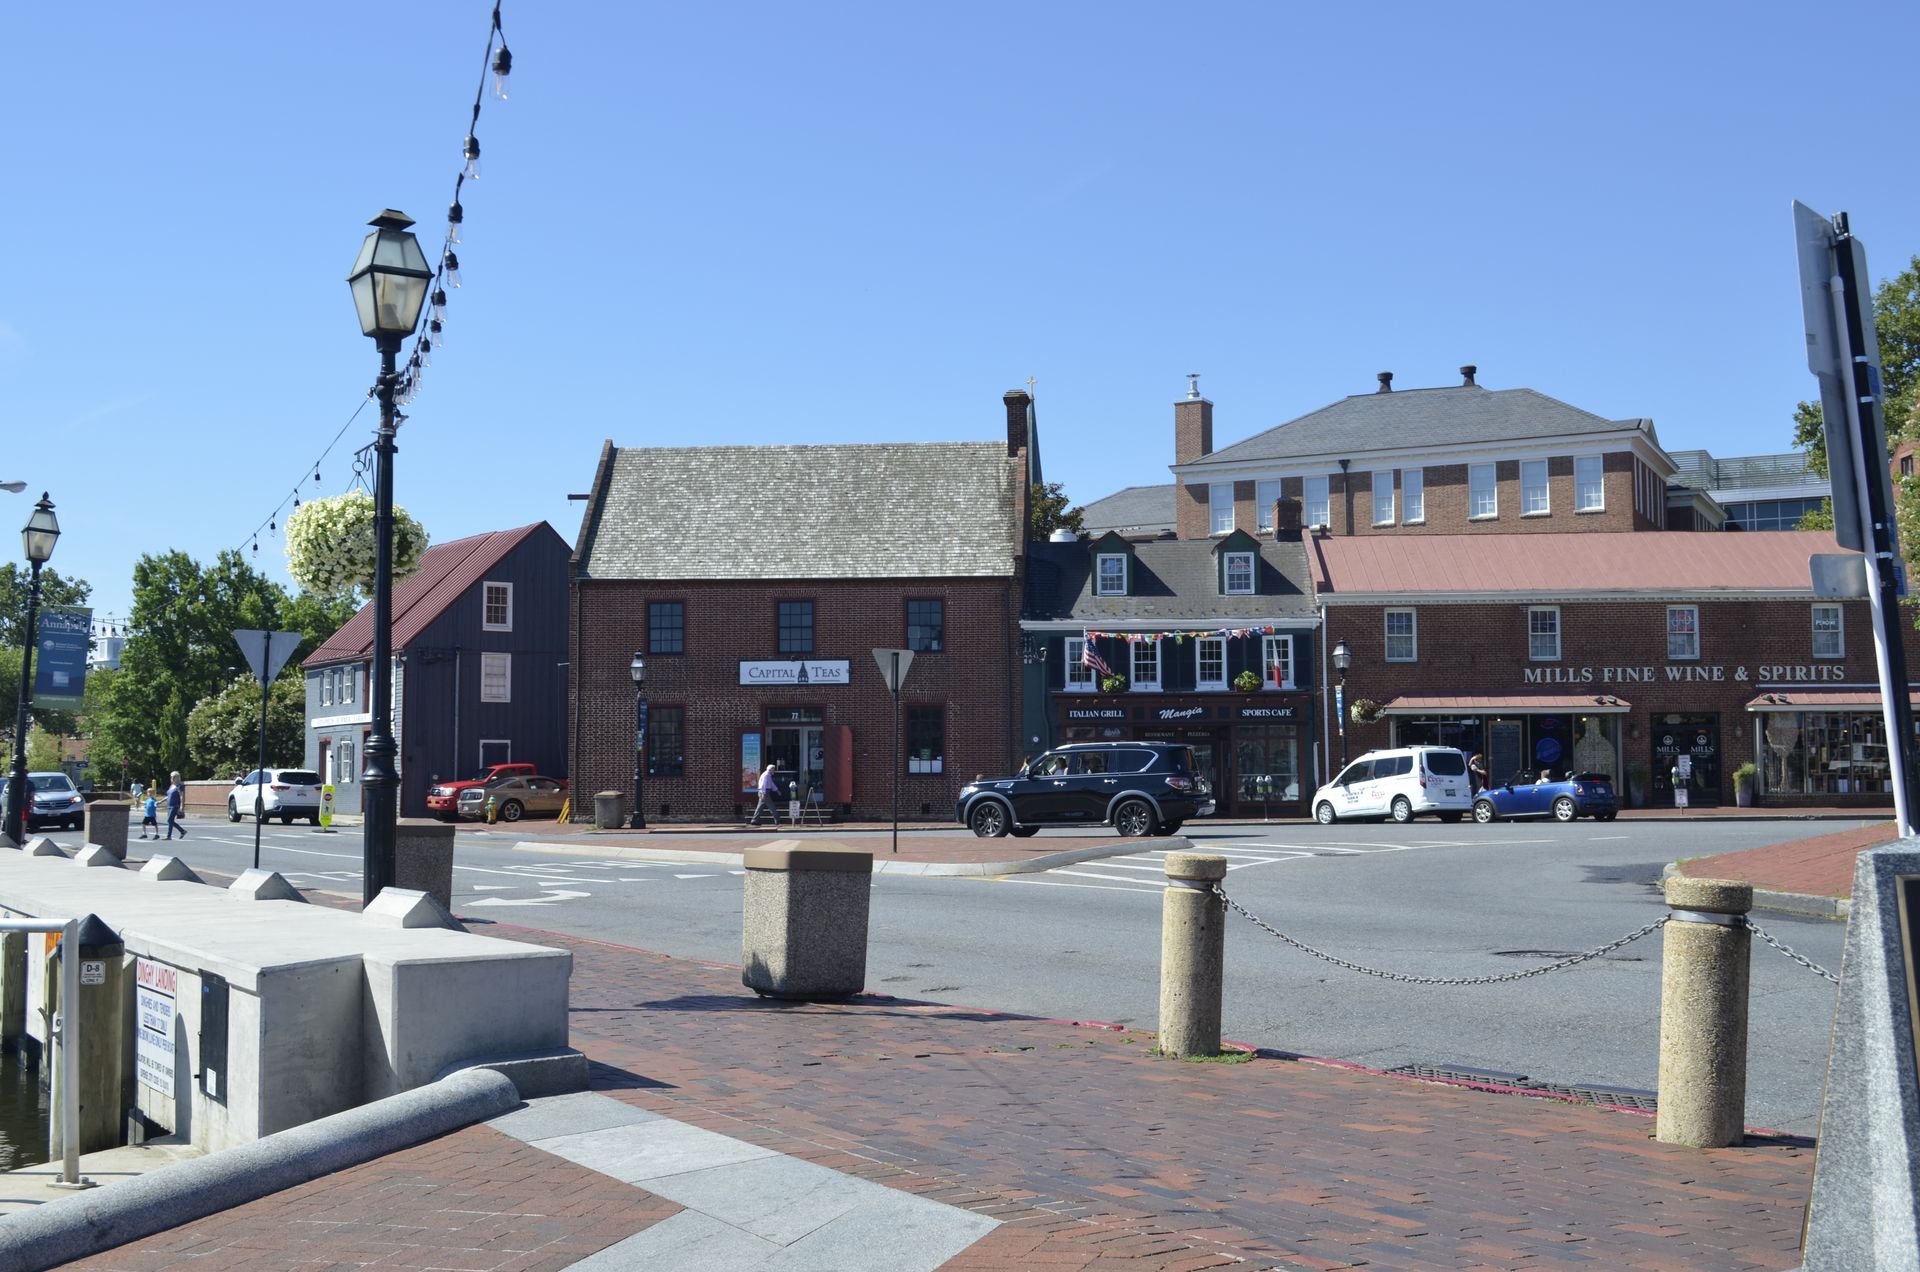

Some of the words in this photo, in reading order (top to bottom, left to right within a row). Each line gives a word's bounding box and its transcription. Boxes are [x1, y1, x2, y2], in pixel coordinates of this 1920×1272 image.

[41, 618, 88, 632] Annapol
[748, 667, 796, 679] CAPITAL
[811, 666, 841, 678] TEAS
[1524, 667, 1593, 683] MILLS
[1602, 667, 1655, 683] FINE
[1664, 666, 1725, 682] WINE
[1734, 666, 1749, 681] &
[1758, 665, 1845, 681] SPIRITS
[791, 712, 799, 720] 77
[1069, 710, 1100, 718] ITALIAN
[1100, 710, 1125, 718] GRILL
[1159, 706, 1203, 719] Mangia
[1241, 709, 1271, 717] SPORTS
[1690, 745, 1715, 753] MILLS
[86, 964, 100, 973] D-8
[155, 966, 176, 993] LANDING
